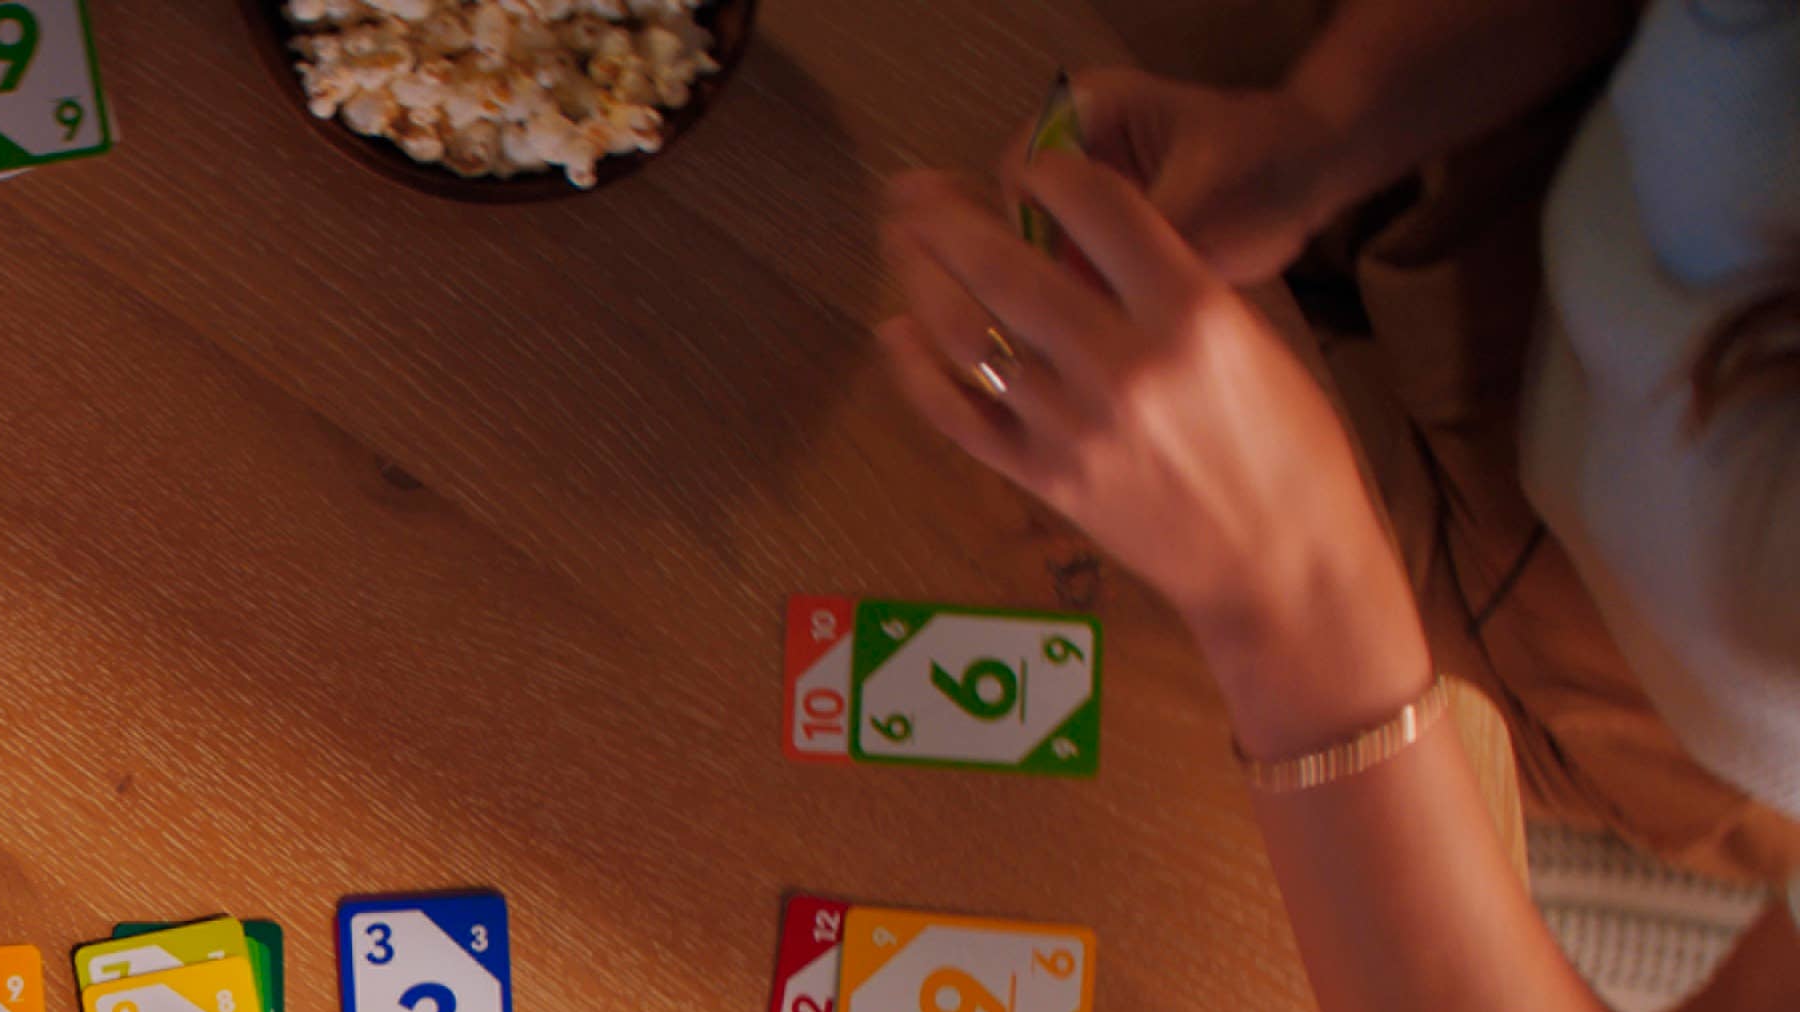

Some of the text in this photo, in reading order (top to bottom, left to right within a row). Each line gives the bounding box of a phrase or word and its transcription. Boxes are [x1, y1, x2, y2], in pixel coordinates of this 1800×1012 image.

[930, 658, 1018, 723] 6
[803, 688, 845, 740] 10
[870, 714, 911, 742] 6
[470, 924, 488, 952] 3
[814, 909, 840, 943] 12
[365, 922, 394, 965] 3
[6, 975, 25, 1001] 9
